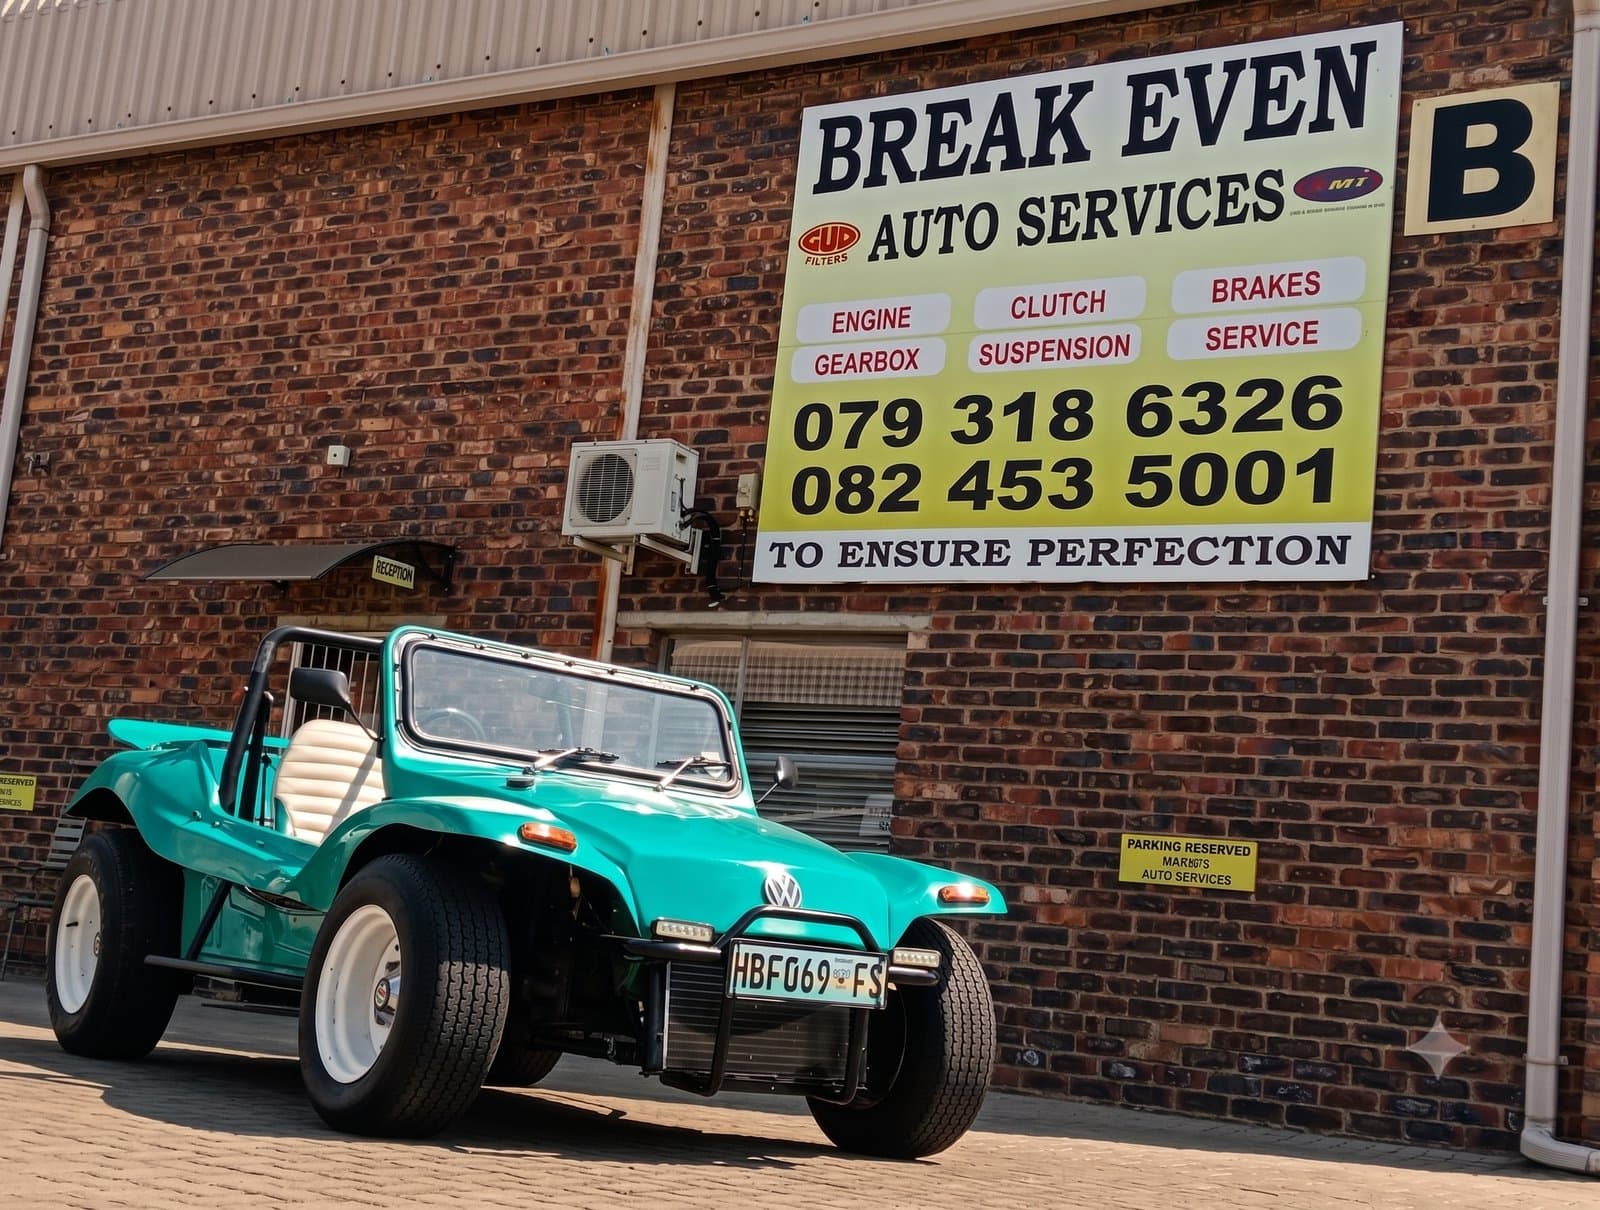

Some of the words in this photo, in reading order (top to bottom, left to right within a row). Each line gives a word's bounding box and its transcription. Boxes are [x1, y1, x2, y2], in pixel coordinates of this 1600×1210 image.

[812, 79, 1094, 195] BREAK
[1121, 40, 1378, 157] EVEN
[1427, 98, 1536, 222] B
[867, 202, 999, 262] AUTO
[1016, 169, 1285, 247] SERVICES
[802, 226, 857, 252] GUD
[805, 253, 848, 266] FILTERS
[1211, 270, 1321, 303] BRAKES
[832, 306, 911, 334] ENGINE
[1010, 289, 1106, 320] CLUTCH
[978, 334, 1131, 366] SUSPENSION
[1205, 320, 1319, 351] SERVICE
[814, 348, 920, 376] GEARBOX
[793, 398, 923, 451] 079
[950, 389, 1094, 445] 318
[1126, 375, 1343, 437] 6326
[791, 462, 922, 516] 082
[947, 457, 1094, 511] 453
[1124, 447, 1335, 508] 5001
[769, 541, 824, 568] TO
[837, 539, 1011, 568] ENSURE
[1026, 535, 1351, 568] PERFECTION
[375, 560, 413, 582] RECEPTION
[1127, 839, 1181, 852] PARKING
[1185, 843, 1251, 856] RESERVED
[1142, 870, 1172, 881] AUTO
[1175, 871, 1232, 885] SERVICES
[735, 951, 831, 995] HBF069
[853, 962, 883, 999] FS
